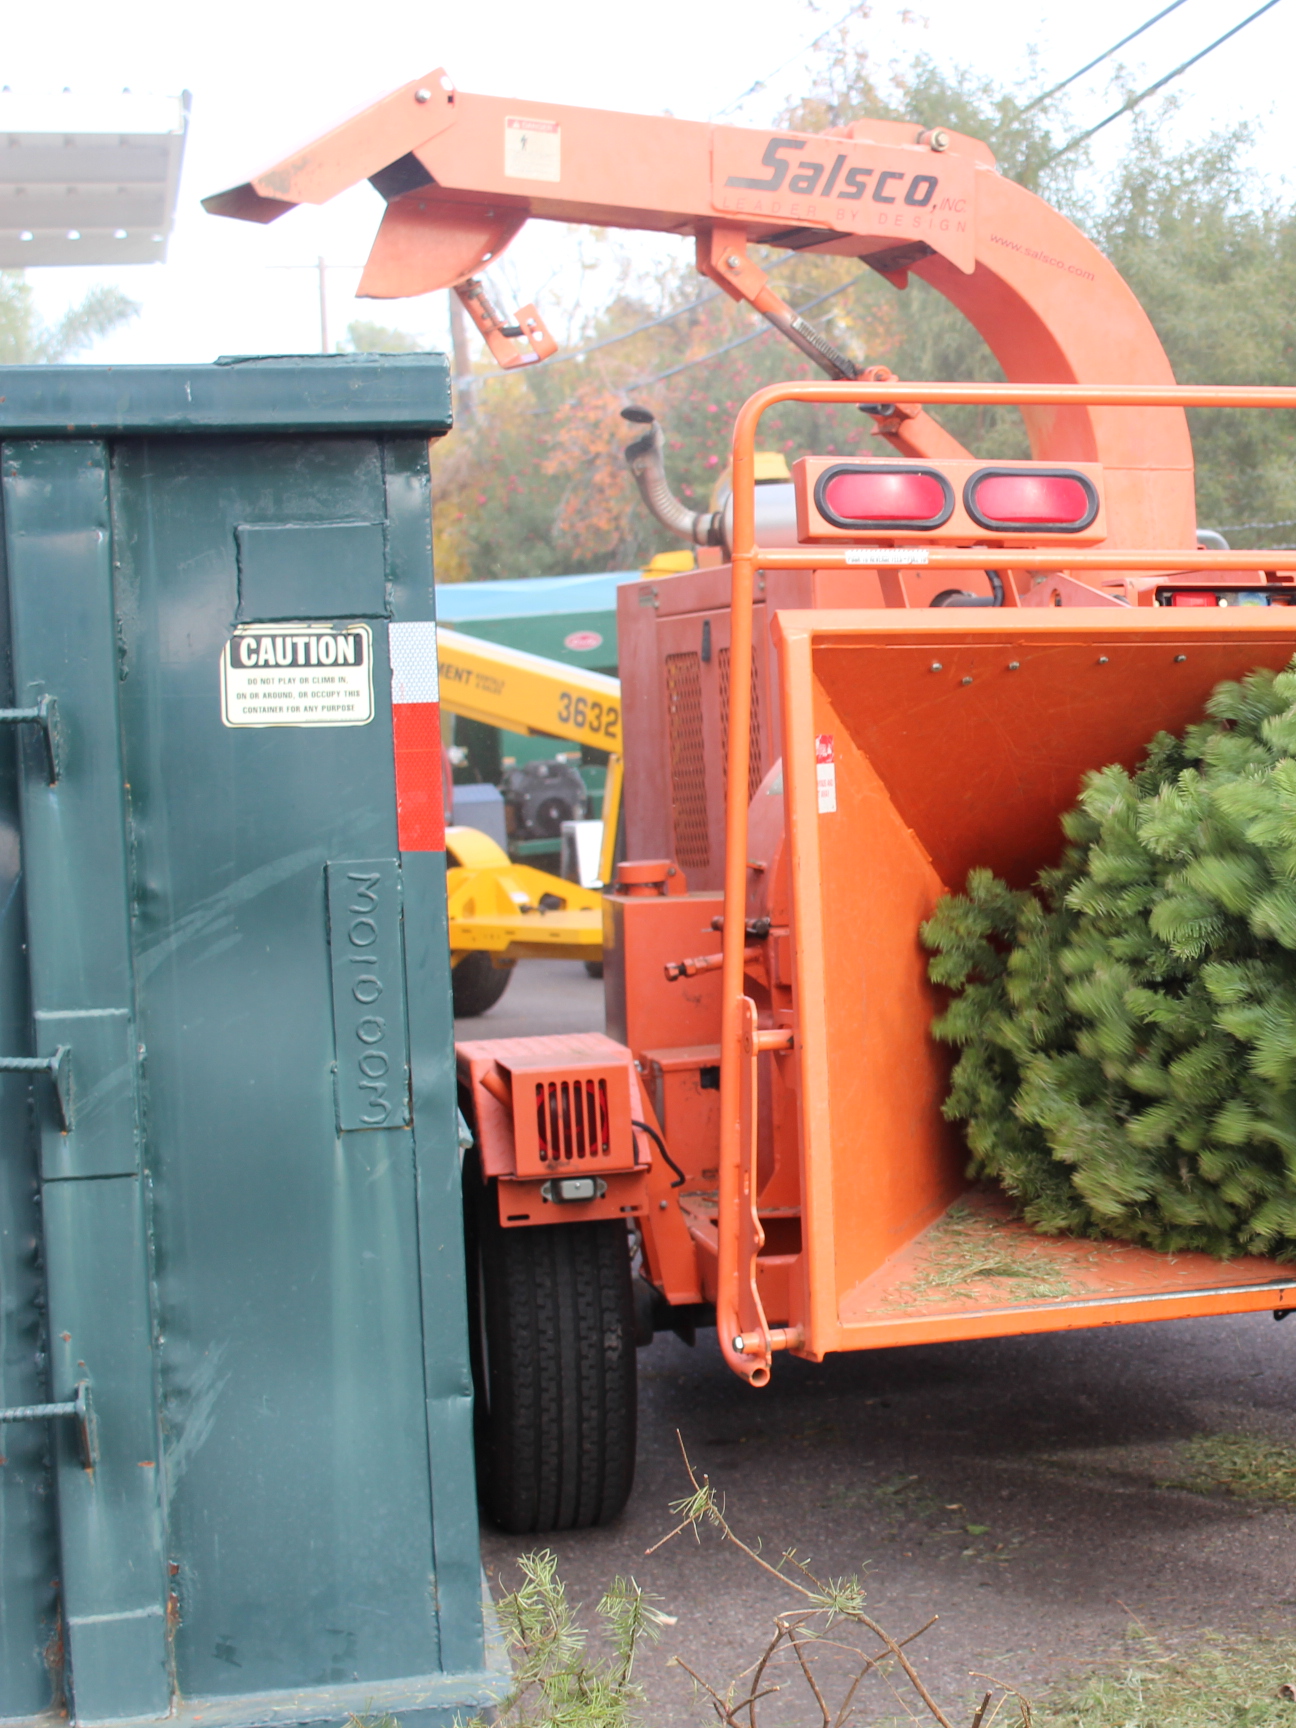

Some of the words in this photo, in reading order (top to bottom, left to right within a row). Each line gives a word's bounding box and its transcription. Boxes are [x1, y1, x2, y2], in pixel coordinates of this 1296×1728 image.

[722, 196, 817, 218] LEADER
[836, 208, 860, 221] BY
[878, 213, 967, 233] DESIGN
[990, 234, 1096, 281] www.salsco.com
[239, 635, 356, 667] CAUTION
[236, 692, 247, 700] ON
[249, 692, 260, 700] OR
[262, 691, 296, 700] AROUND,
[298, 691, 309, 699] OR
[311, 690, 341, 698] OCCUPY
[247, 678, 258, 686] DO
[260, 677, 276, 685] NOT
[278, 677, 297, 685] PLAY
[299, 676, 310, 684] OR
[312, 676, 336, 684] CLIMB
[242, 706, 284, 714] CONTAINER
[286, 705, 301, 713] FOR
[321, 704, 356, 712] PURPOSE
[557, 691, 619, 739] 3632
